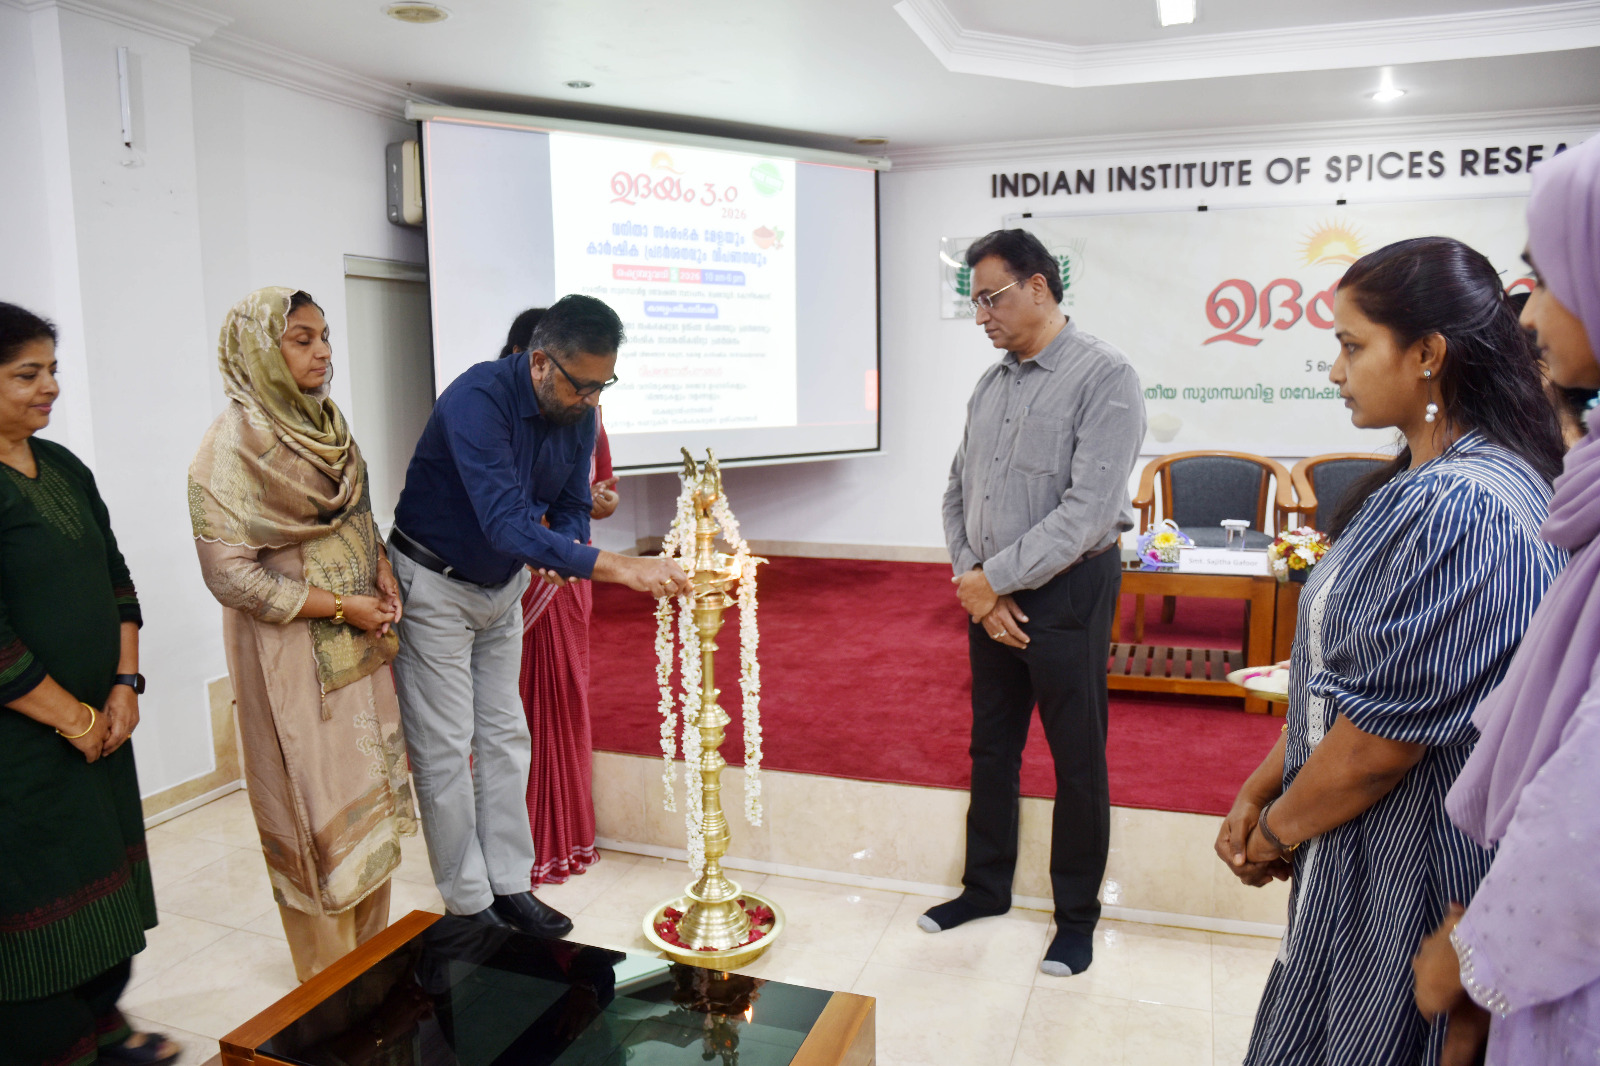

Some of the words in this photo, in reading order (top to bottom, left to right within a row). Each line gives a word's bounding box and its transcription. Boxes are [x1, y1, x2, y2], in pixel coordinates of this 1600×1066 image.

[992, 168, 1095, 198] INDIAN
[1108, 159, 1252, 193] INSTITUTE
[1266, 156, 1311, 185] OF
[1326, 150, 1445, 184] SPICES
[610, 171, 696, 206] ഉദയം
[700, 183, 738, 206] 3.0
[722, 207, 746, 219] 2026
[680, 271, 700, 281] 2026
[1305, 360, 1313, 372] 5
[1182, 383, 1274, 404] സുഗന്ധവിള
